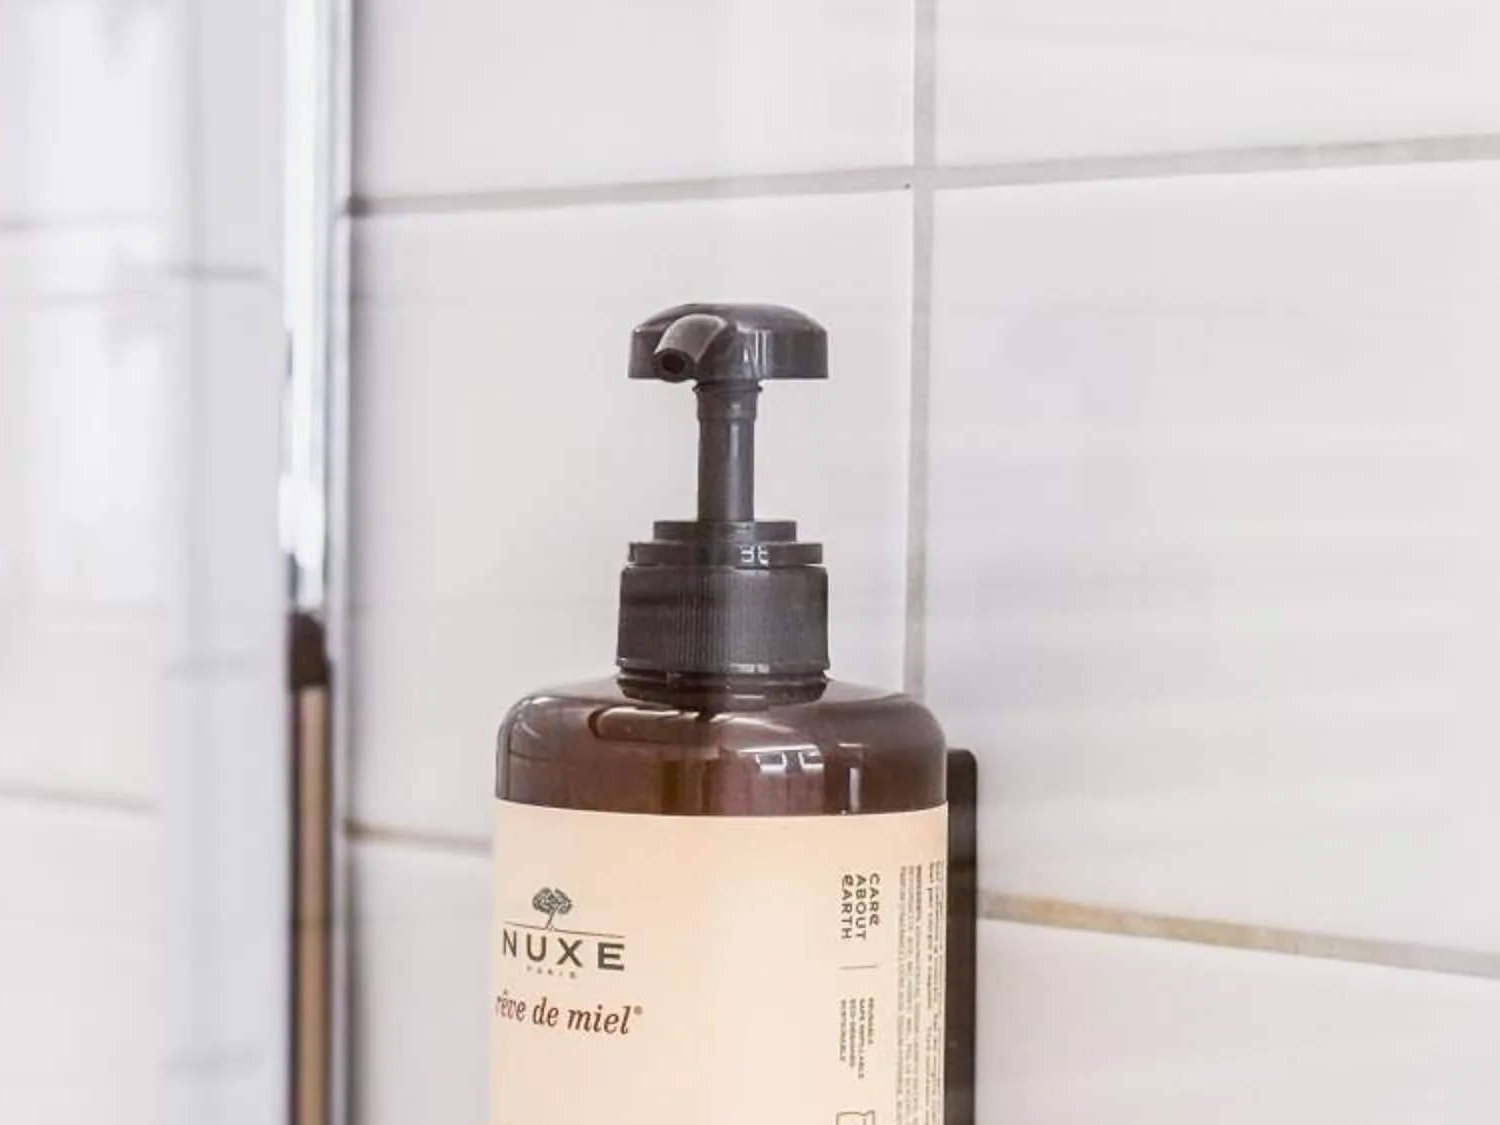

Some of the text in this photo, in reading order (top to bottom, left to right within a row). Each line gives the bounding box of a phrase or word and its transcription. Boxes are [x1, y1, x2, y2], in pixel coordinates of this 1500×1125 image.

[855, 874, 867, 940] ABOUT
[503, 928, 625, 971] NUXE
[532, 996, 559, 1027] de
